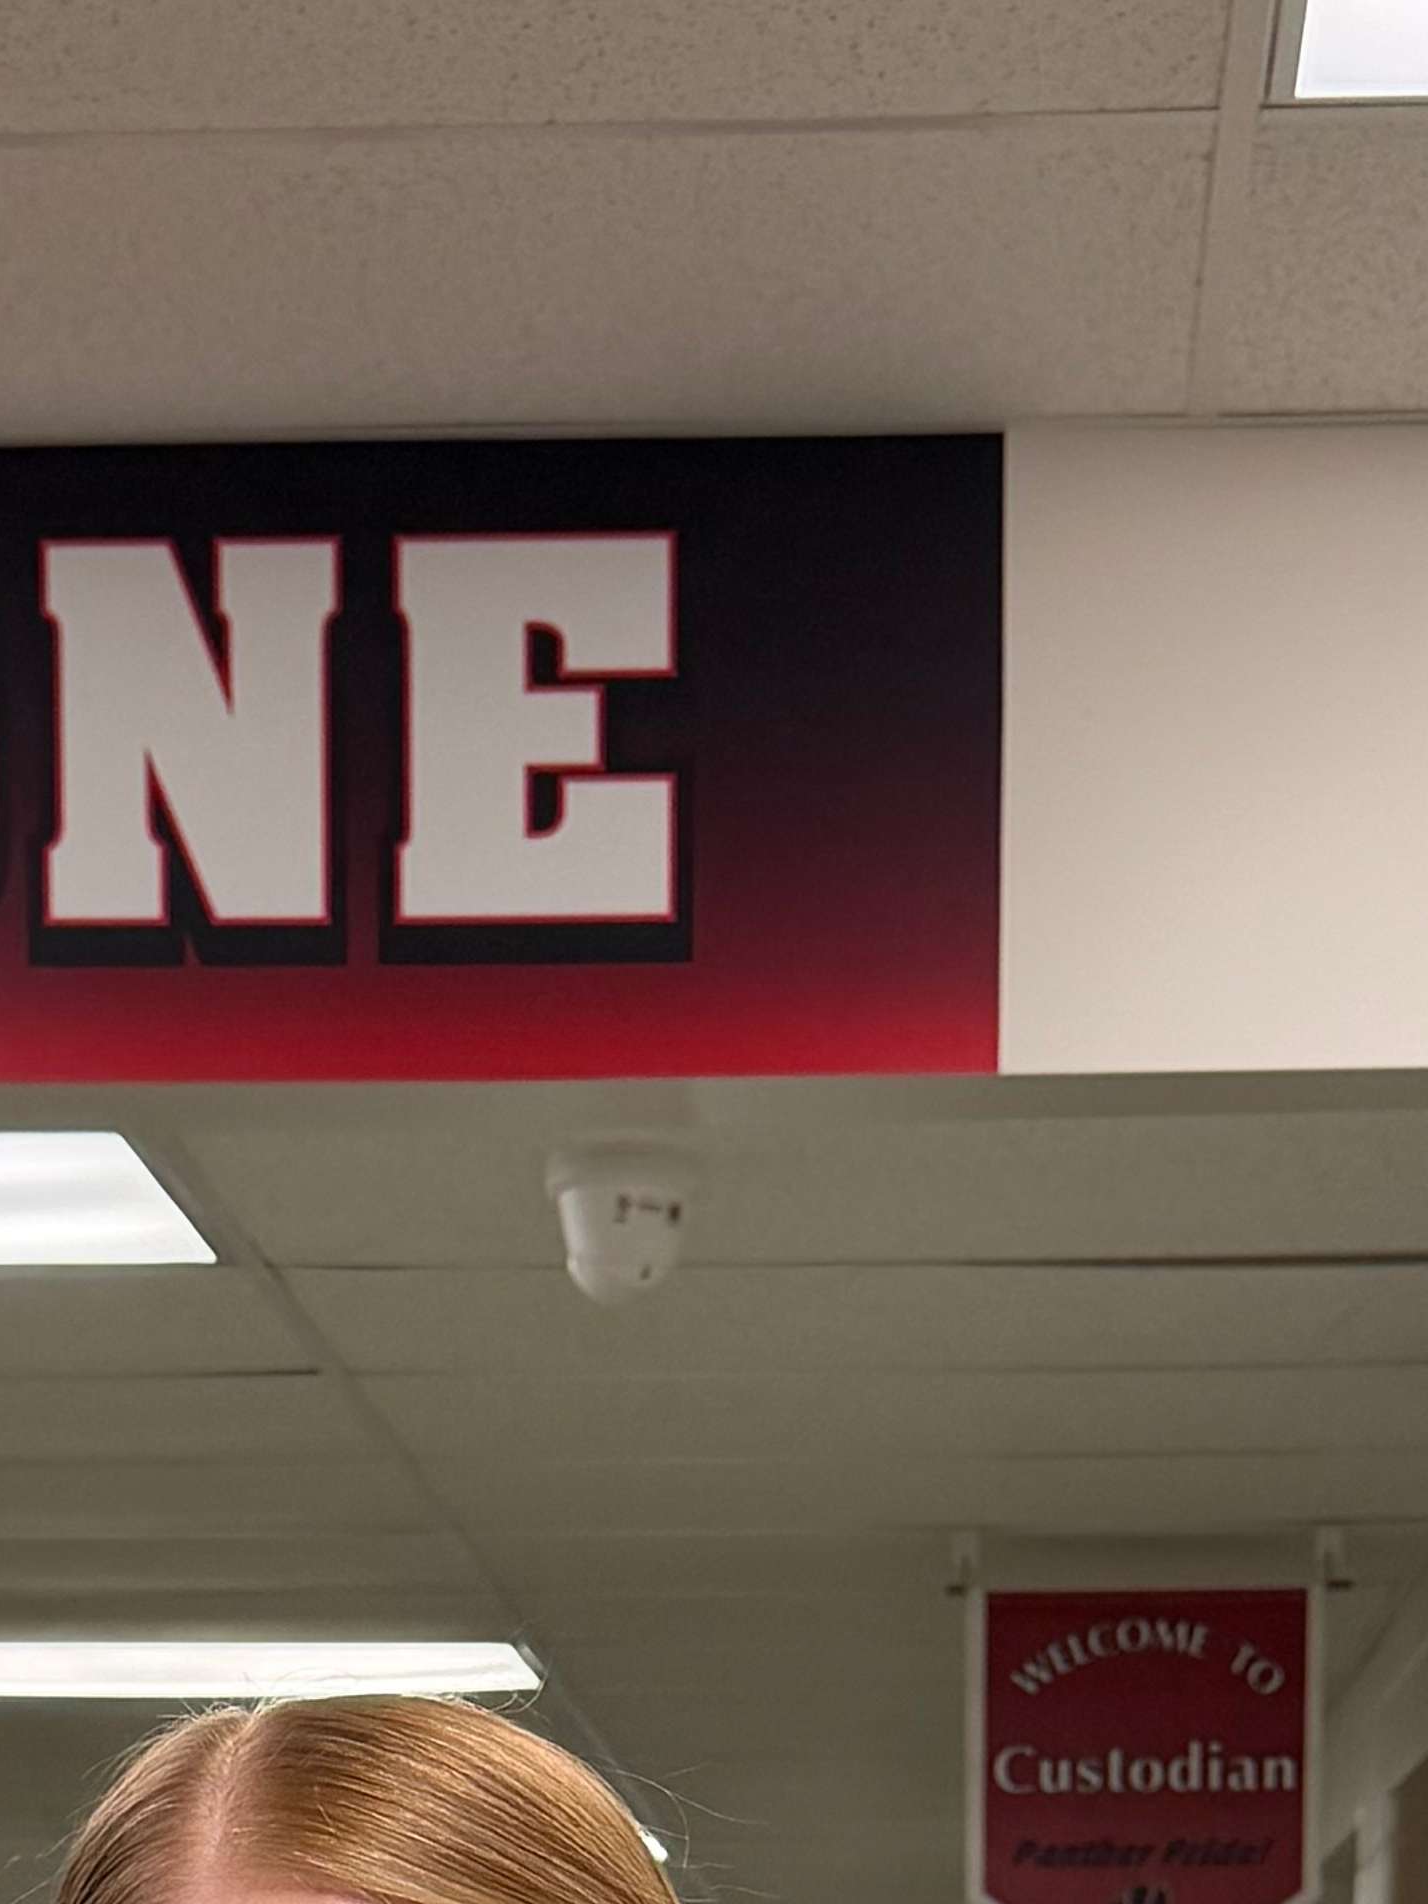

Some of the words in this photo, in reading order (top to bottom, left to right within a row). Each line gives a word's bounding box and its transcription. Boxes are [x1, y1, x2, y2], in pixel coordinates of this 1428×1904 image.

[1010, 1617, 1210, 1695] WELCOME
[1230, 1641, 1285, 1695] TO
[993, 1740, 1298, 1793] Custodian
